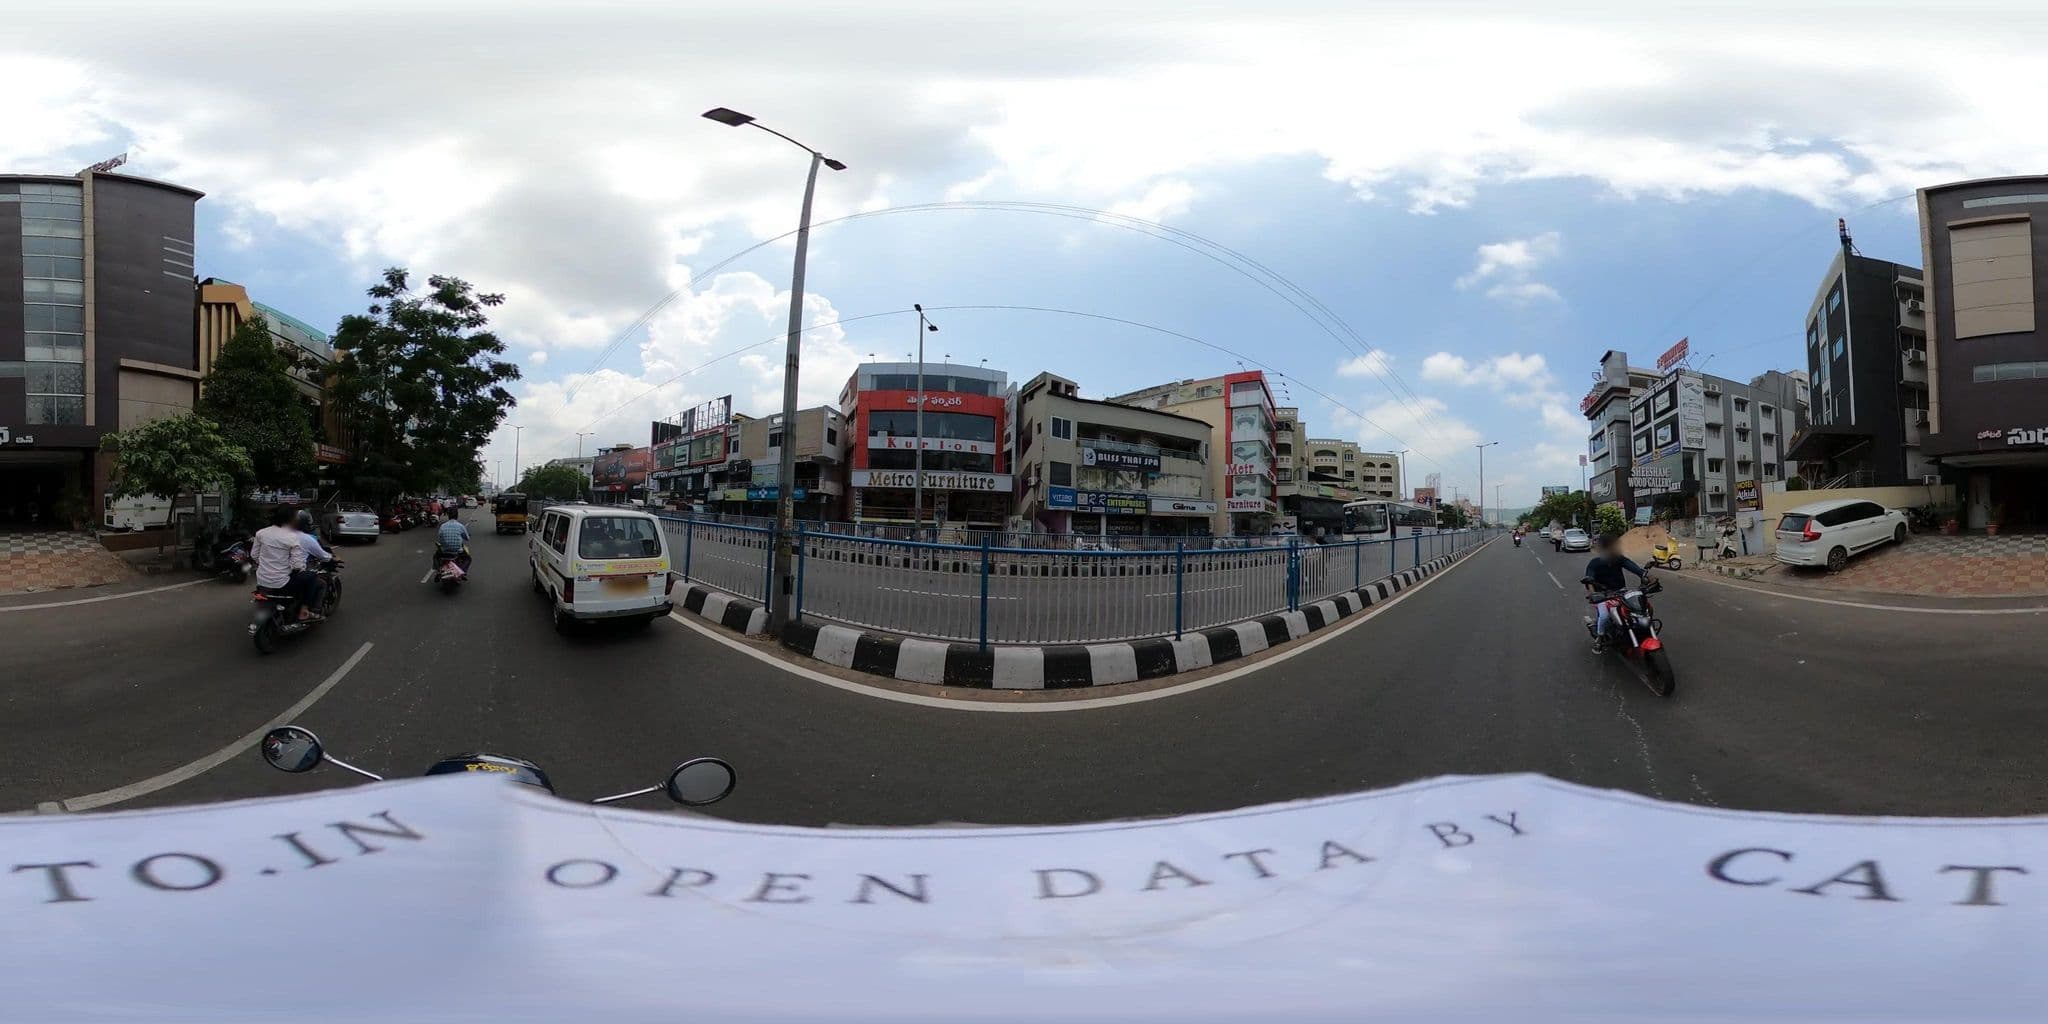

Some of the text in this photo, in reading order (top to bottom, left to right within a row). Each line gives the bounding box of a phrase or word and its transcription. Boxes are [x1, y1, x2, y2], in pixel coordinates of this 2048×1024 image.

[1098, 453, 1159, 467] BLISS THAI SPA
[868, 472, 996, 490] Metro Furniture
[1628, 477, 1647, 488] WOOD
[1736, 481, 1754, 490] HOTEL
[1107, 498, 1146, 508] ENTERPRISES
[1227, 500, 1262, 509] Furniture
[546, 858, 933, 904] OPEN
[1033, 840, 1376, 900] DATA
[1423, 811, 1530, 849] BY
